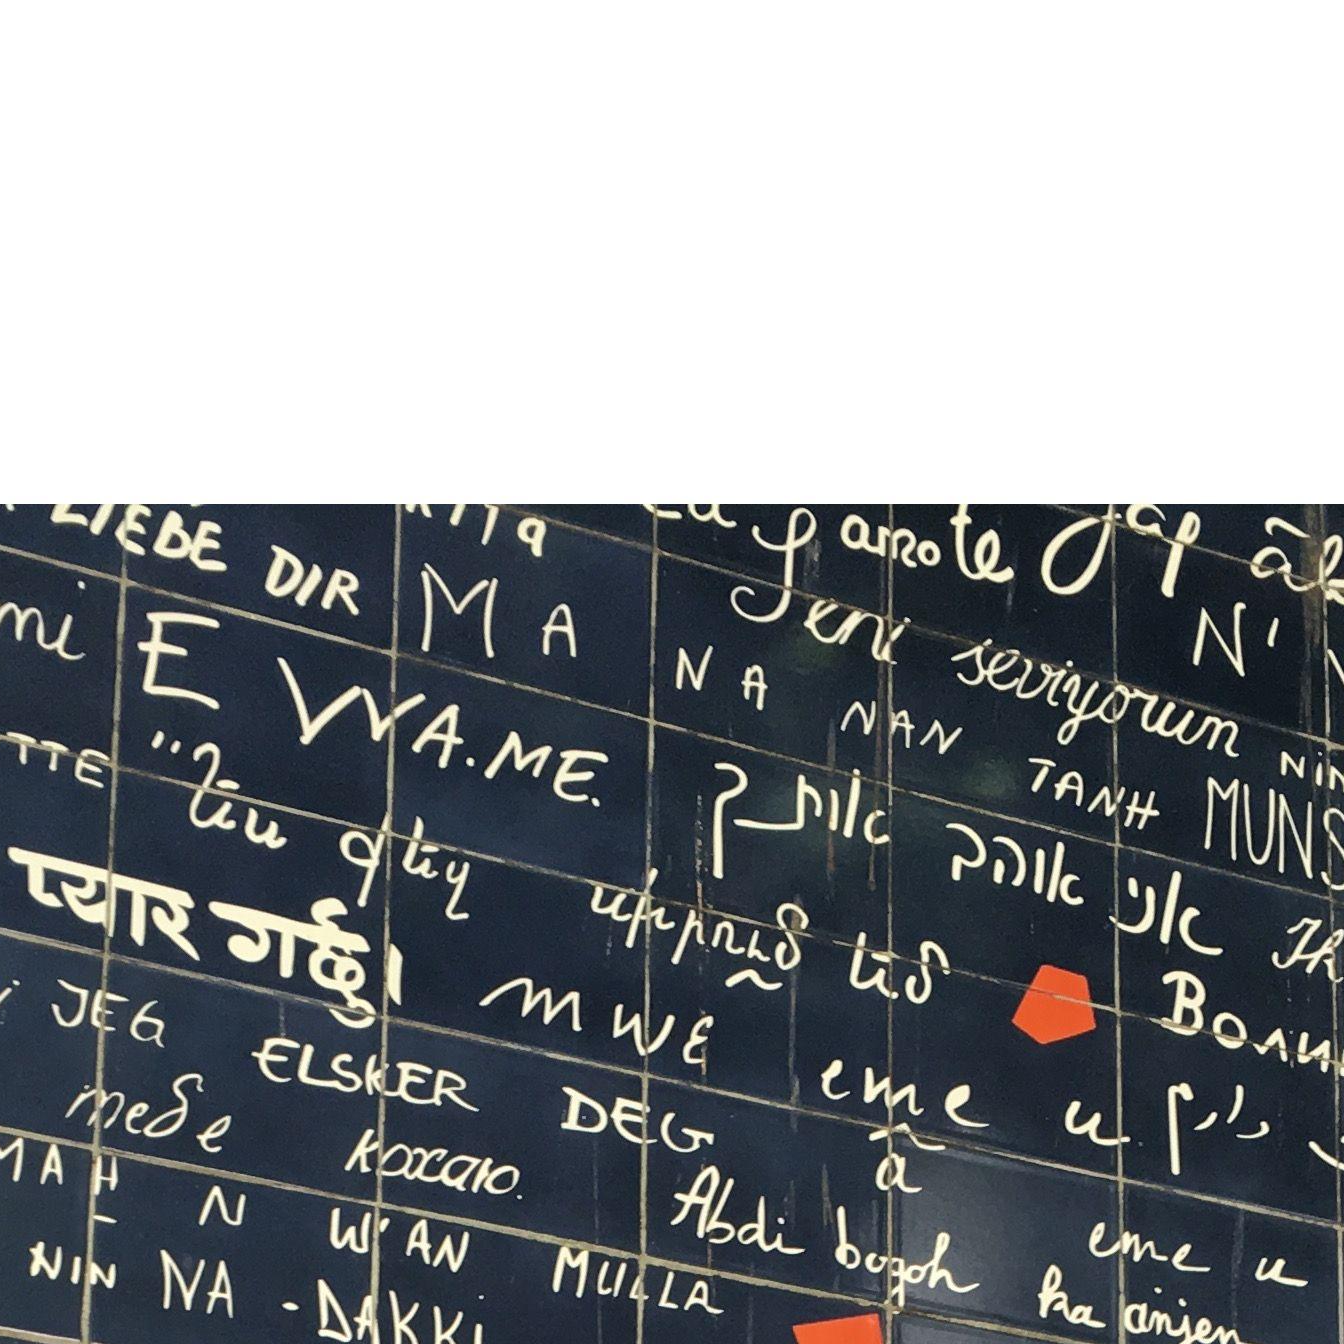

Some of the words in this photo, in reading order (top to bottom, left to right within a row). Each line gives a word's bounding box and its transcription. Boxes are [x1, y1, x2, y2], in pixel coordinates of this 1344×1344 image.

[265, 545, 359, 615] DIR
[7, 845, 201, 961] प्यार
[51, 977, 167, 1049] JEG
[251, 1037, 479, 1112] ELSKER
[561, 1086, 715, 1153] DEG
[552, 1245, 724, 1316] MULLA
